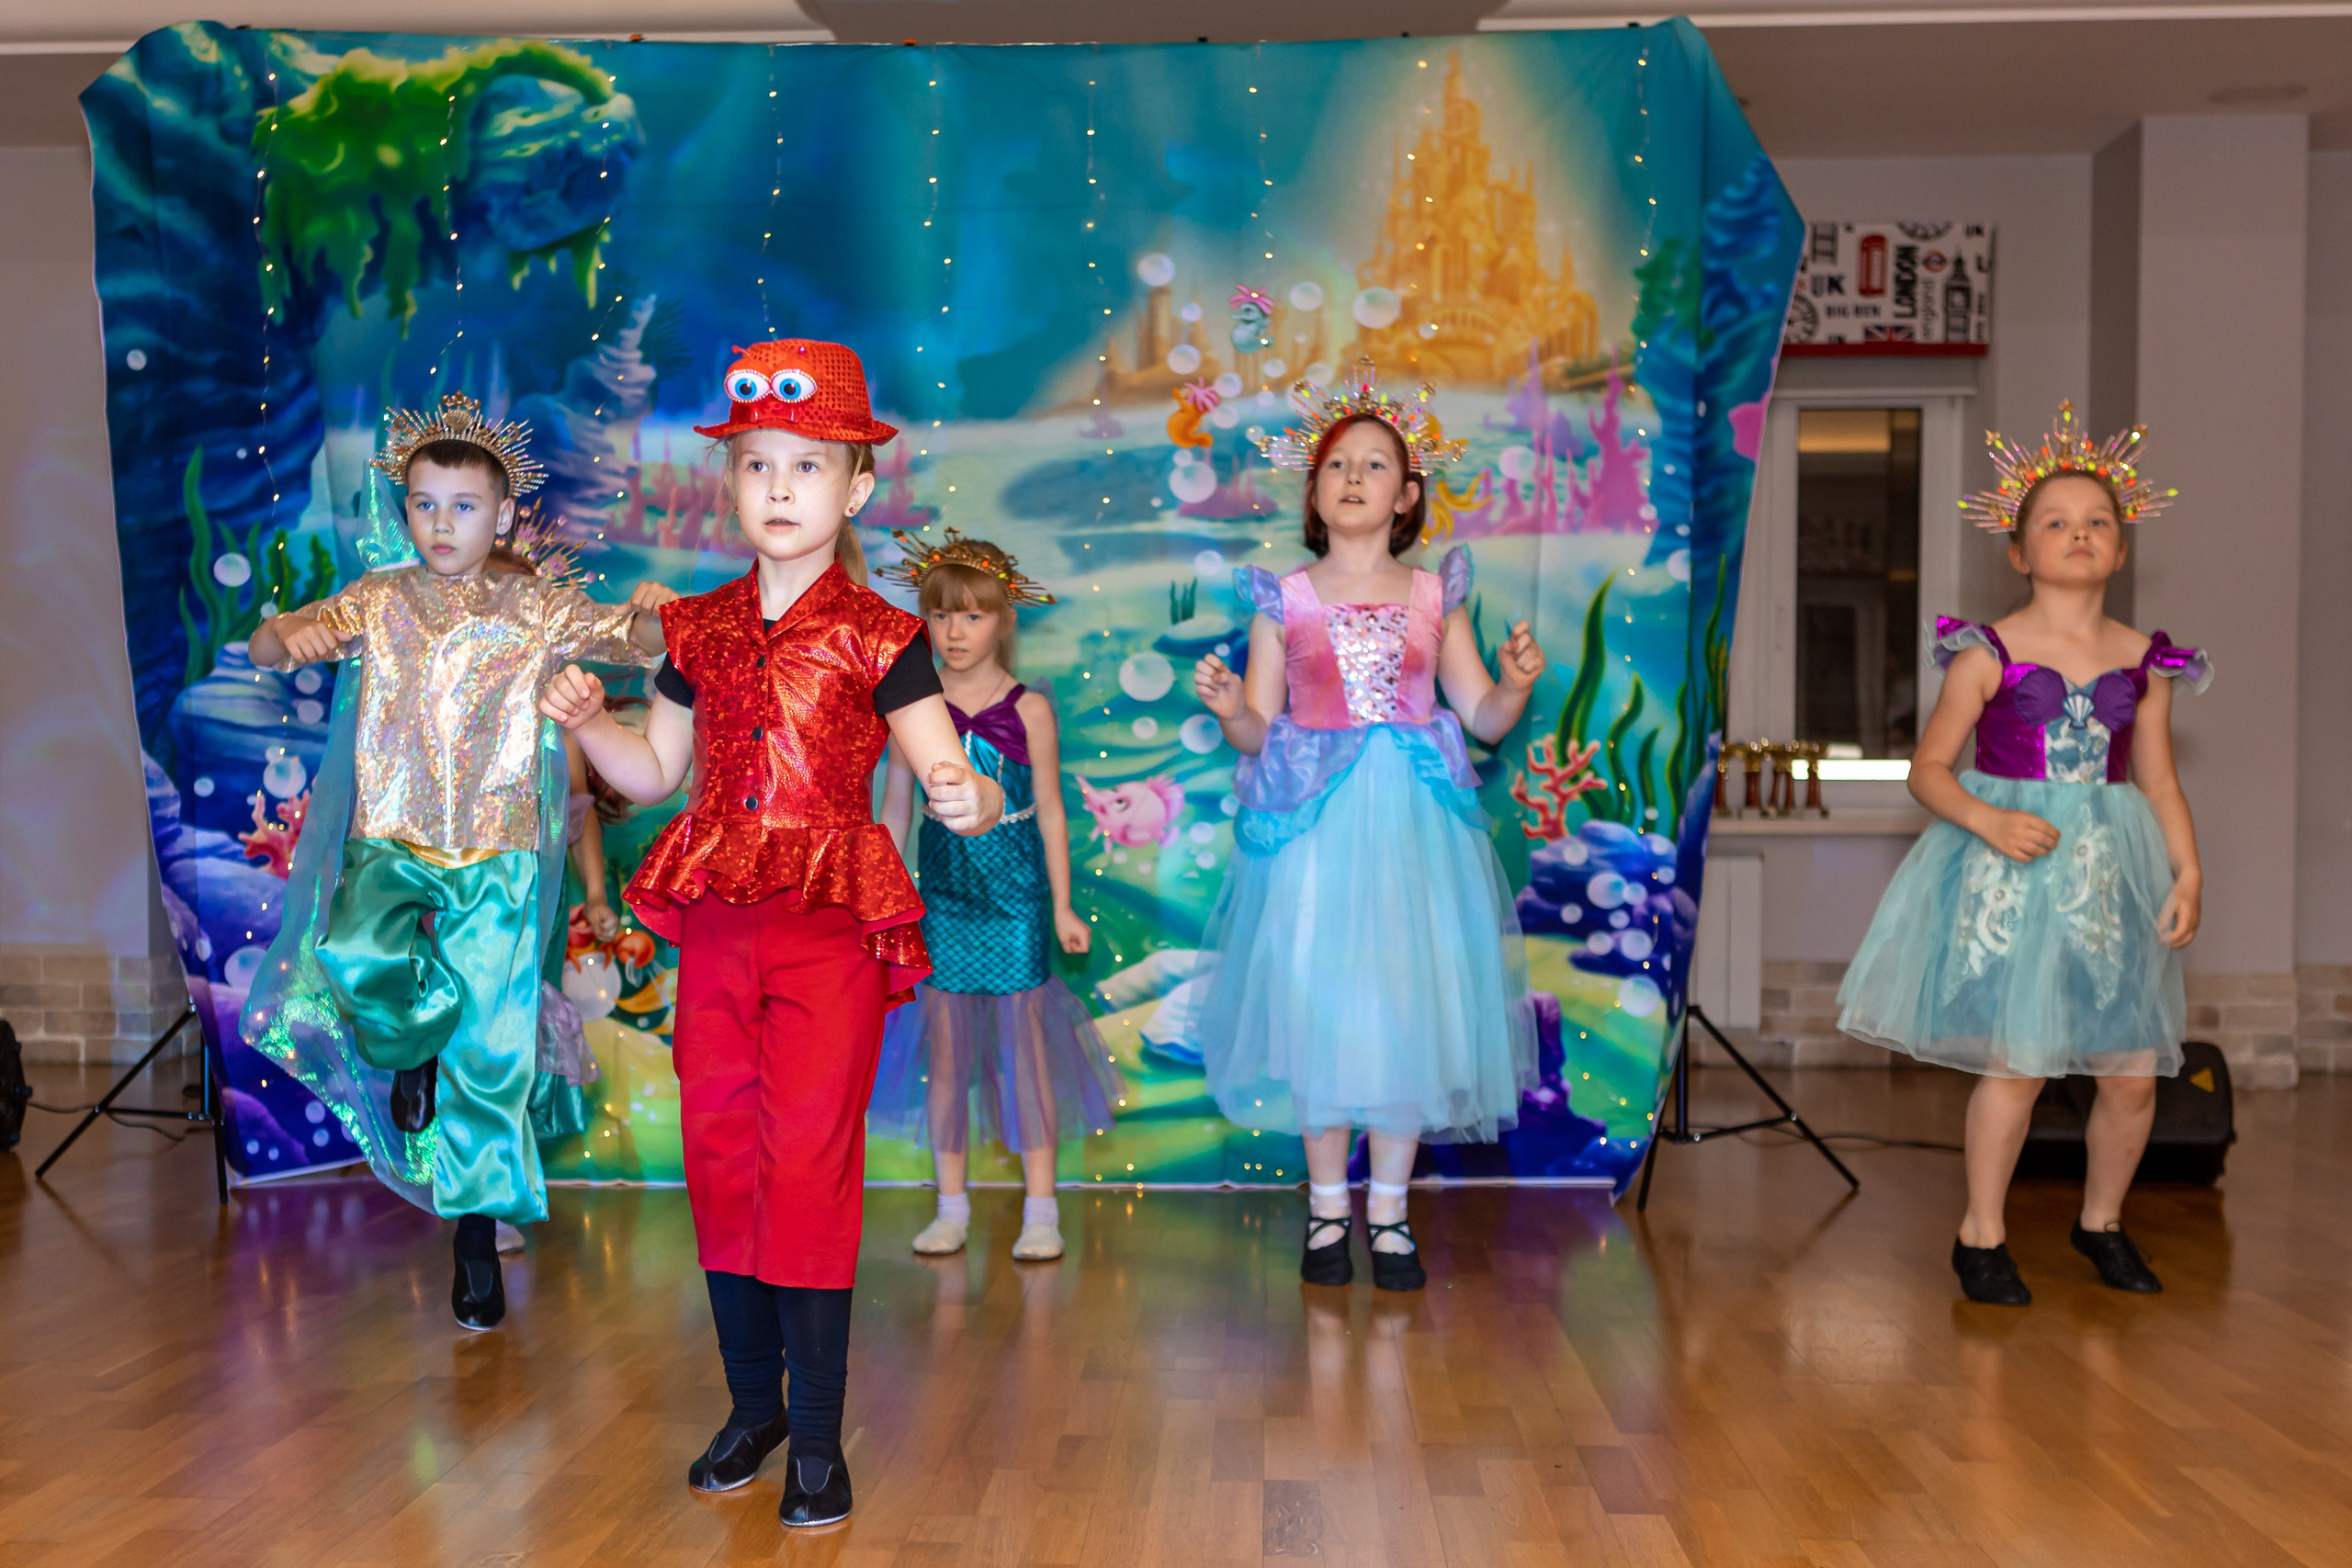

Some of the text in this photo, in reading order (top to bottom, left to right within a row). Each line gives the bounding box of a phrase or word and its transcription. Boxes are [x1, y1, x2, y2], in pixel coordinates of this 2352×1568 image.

[1811, 275, 1845, 297] UK
[1894, 244, 1917, 319] LONDON
[1826, 304, 1881, 318] BIG BEN
